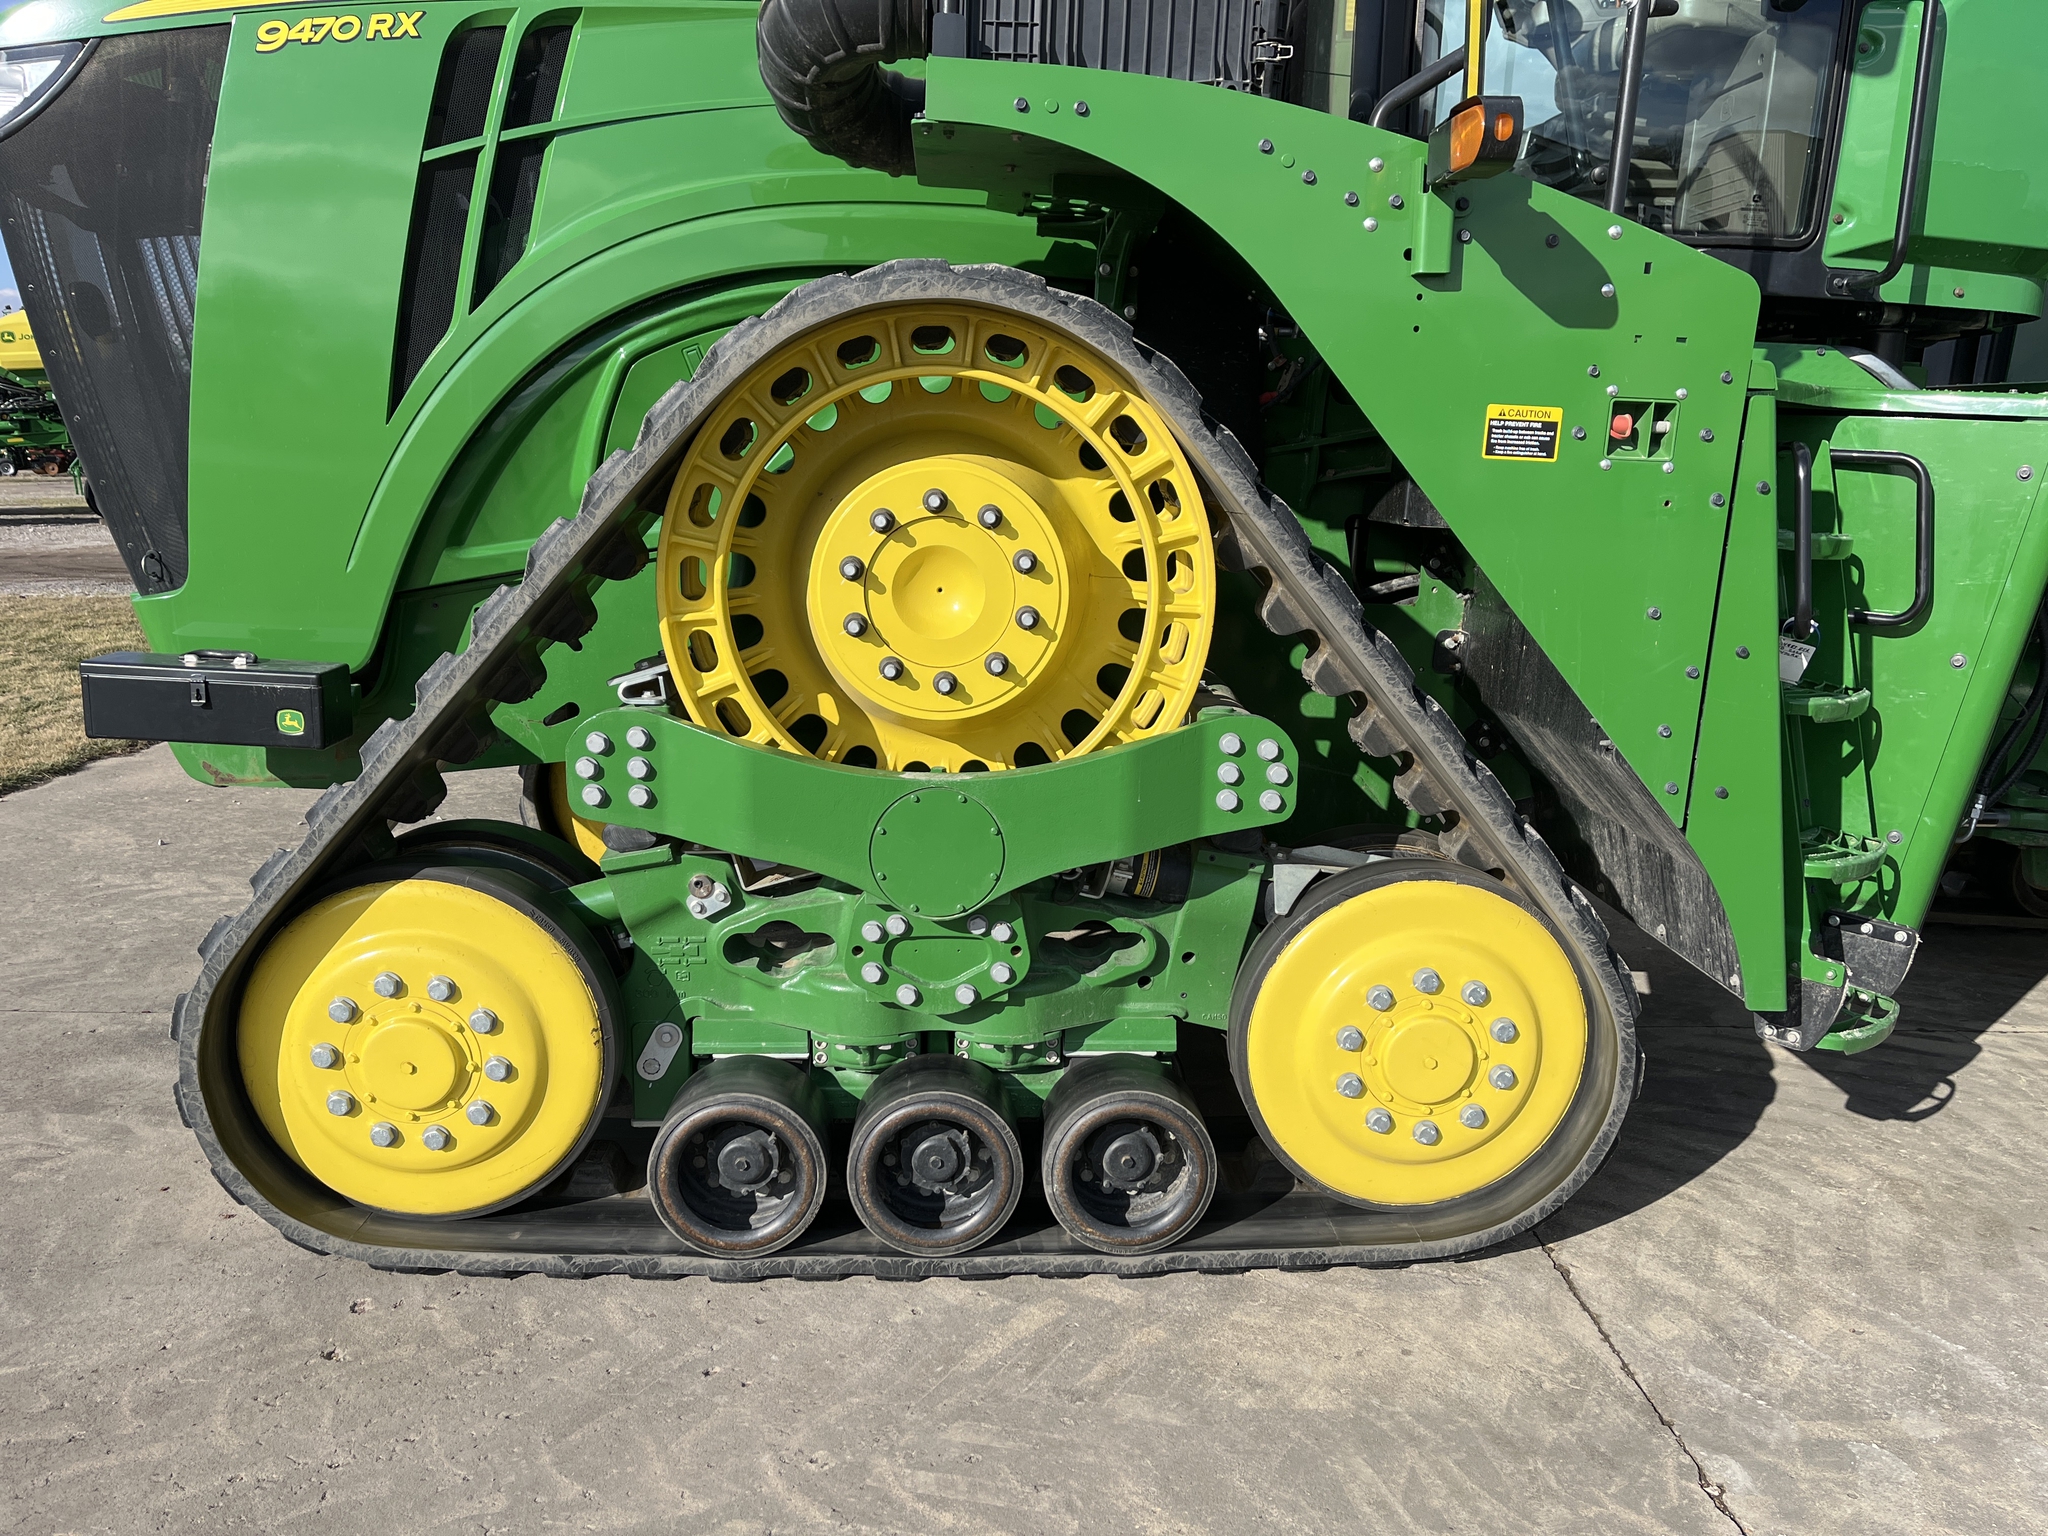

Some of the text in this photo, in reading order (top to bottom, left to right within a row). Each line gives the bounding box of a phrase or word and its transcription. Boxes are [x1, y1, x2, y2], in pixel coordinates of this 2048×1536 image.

[255, 11, 427, 54] 9470 RX
[1508, 409, 1552, 419] CAUTION
